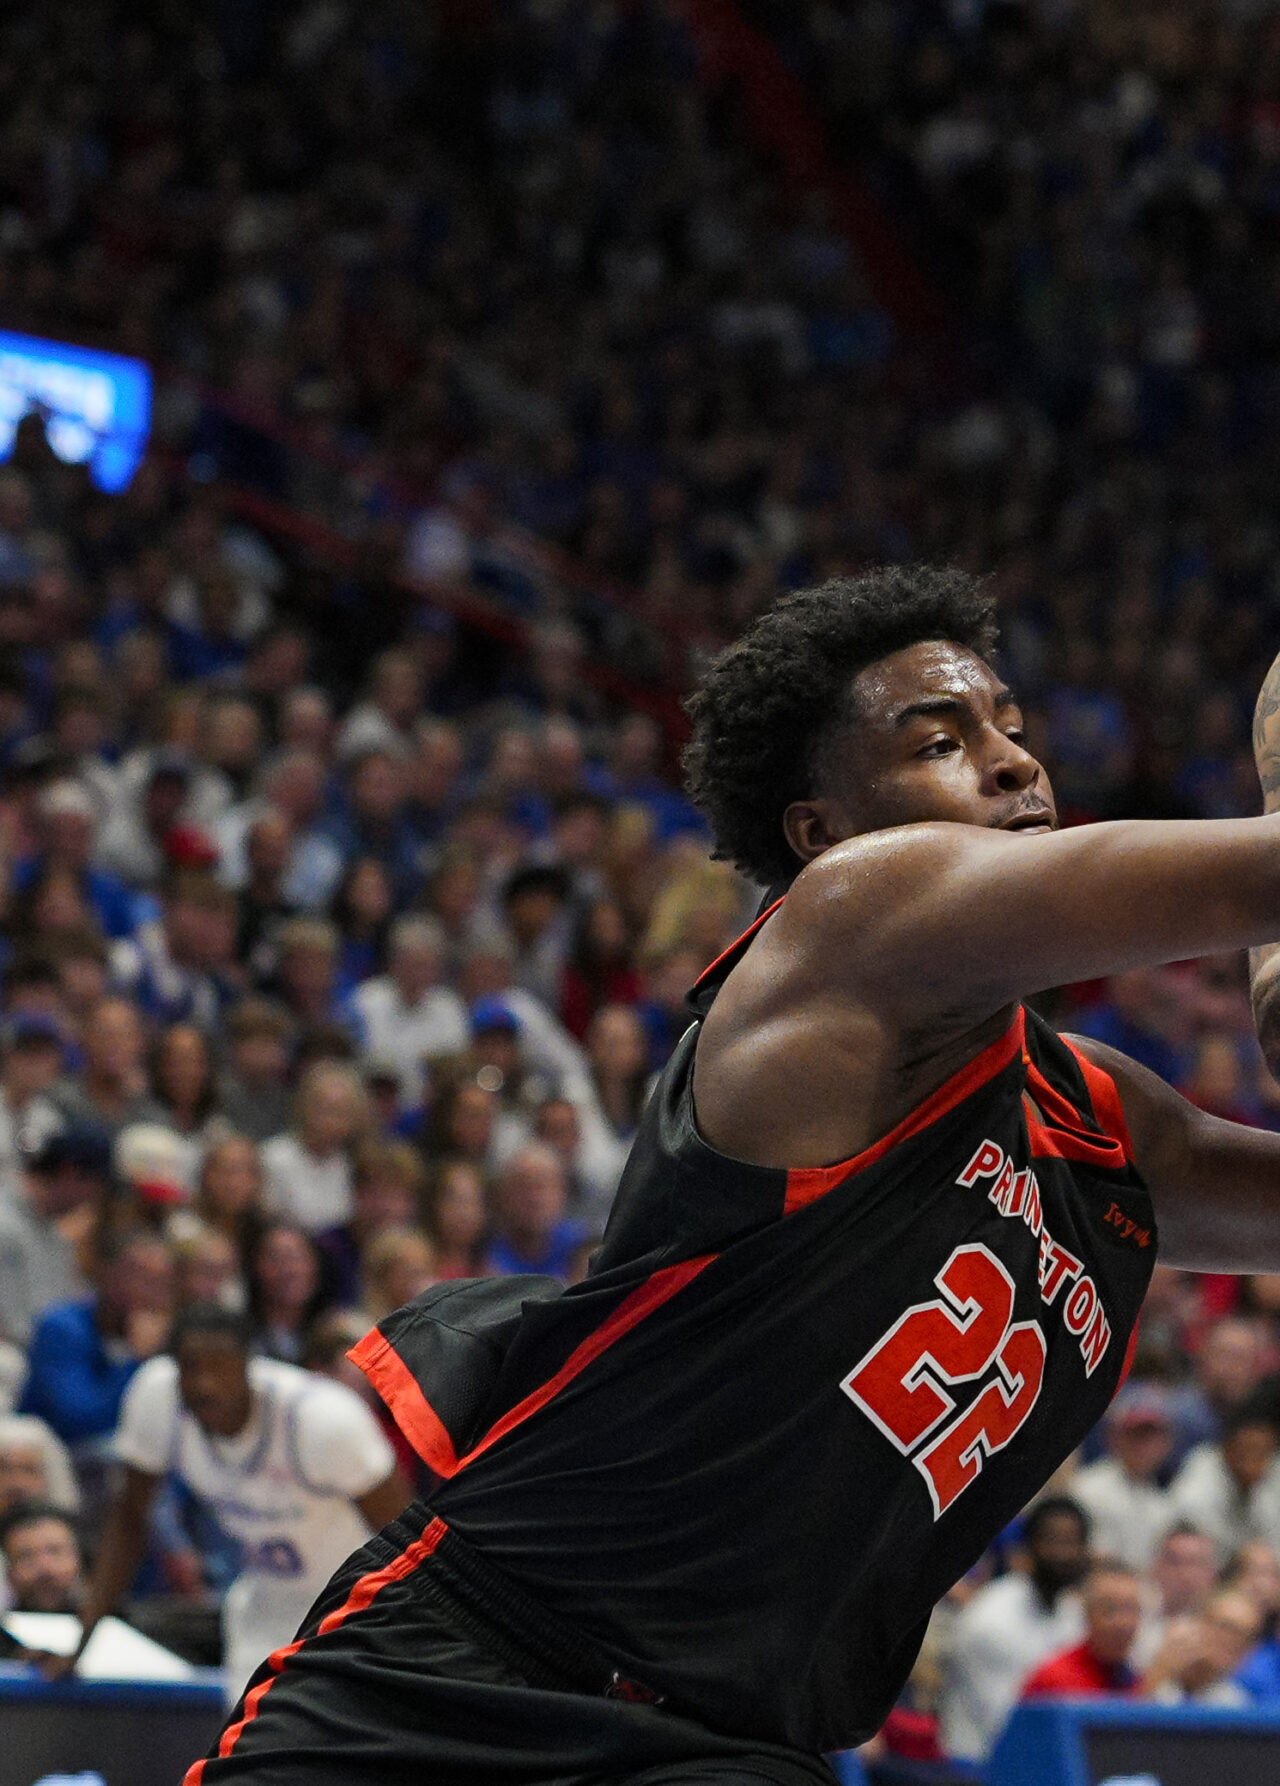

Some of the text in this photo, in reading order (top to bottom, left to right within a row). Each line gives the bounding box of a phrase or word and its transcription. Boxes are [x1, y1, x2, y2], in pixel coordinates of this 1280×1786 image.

[956, 1139, 1111, 1379] PRINETON
[1103, 1203, 1138, 1238] Ivy
[839, 1242, 1047, 1521] 22
